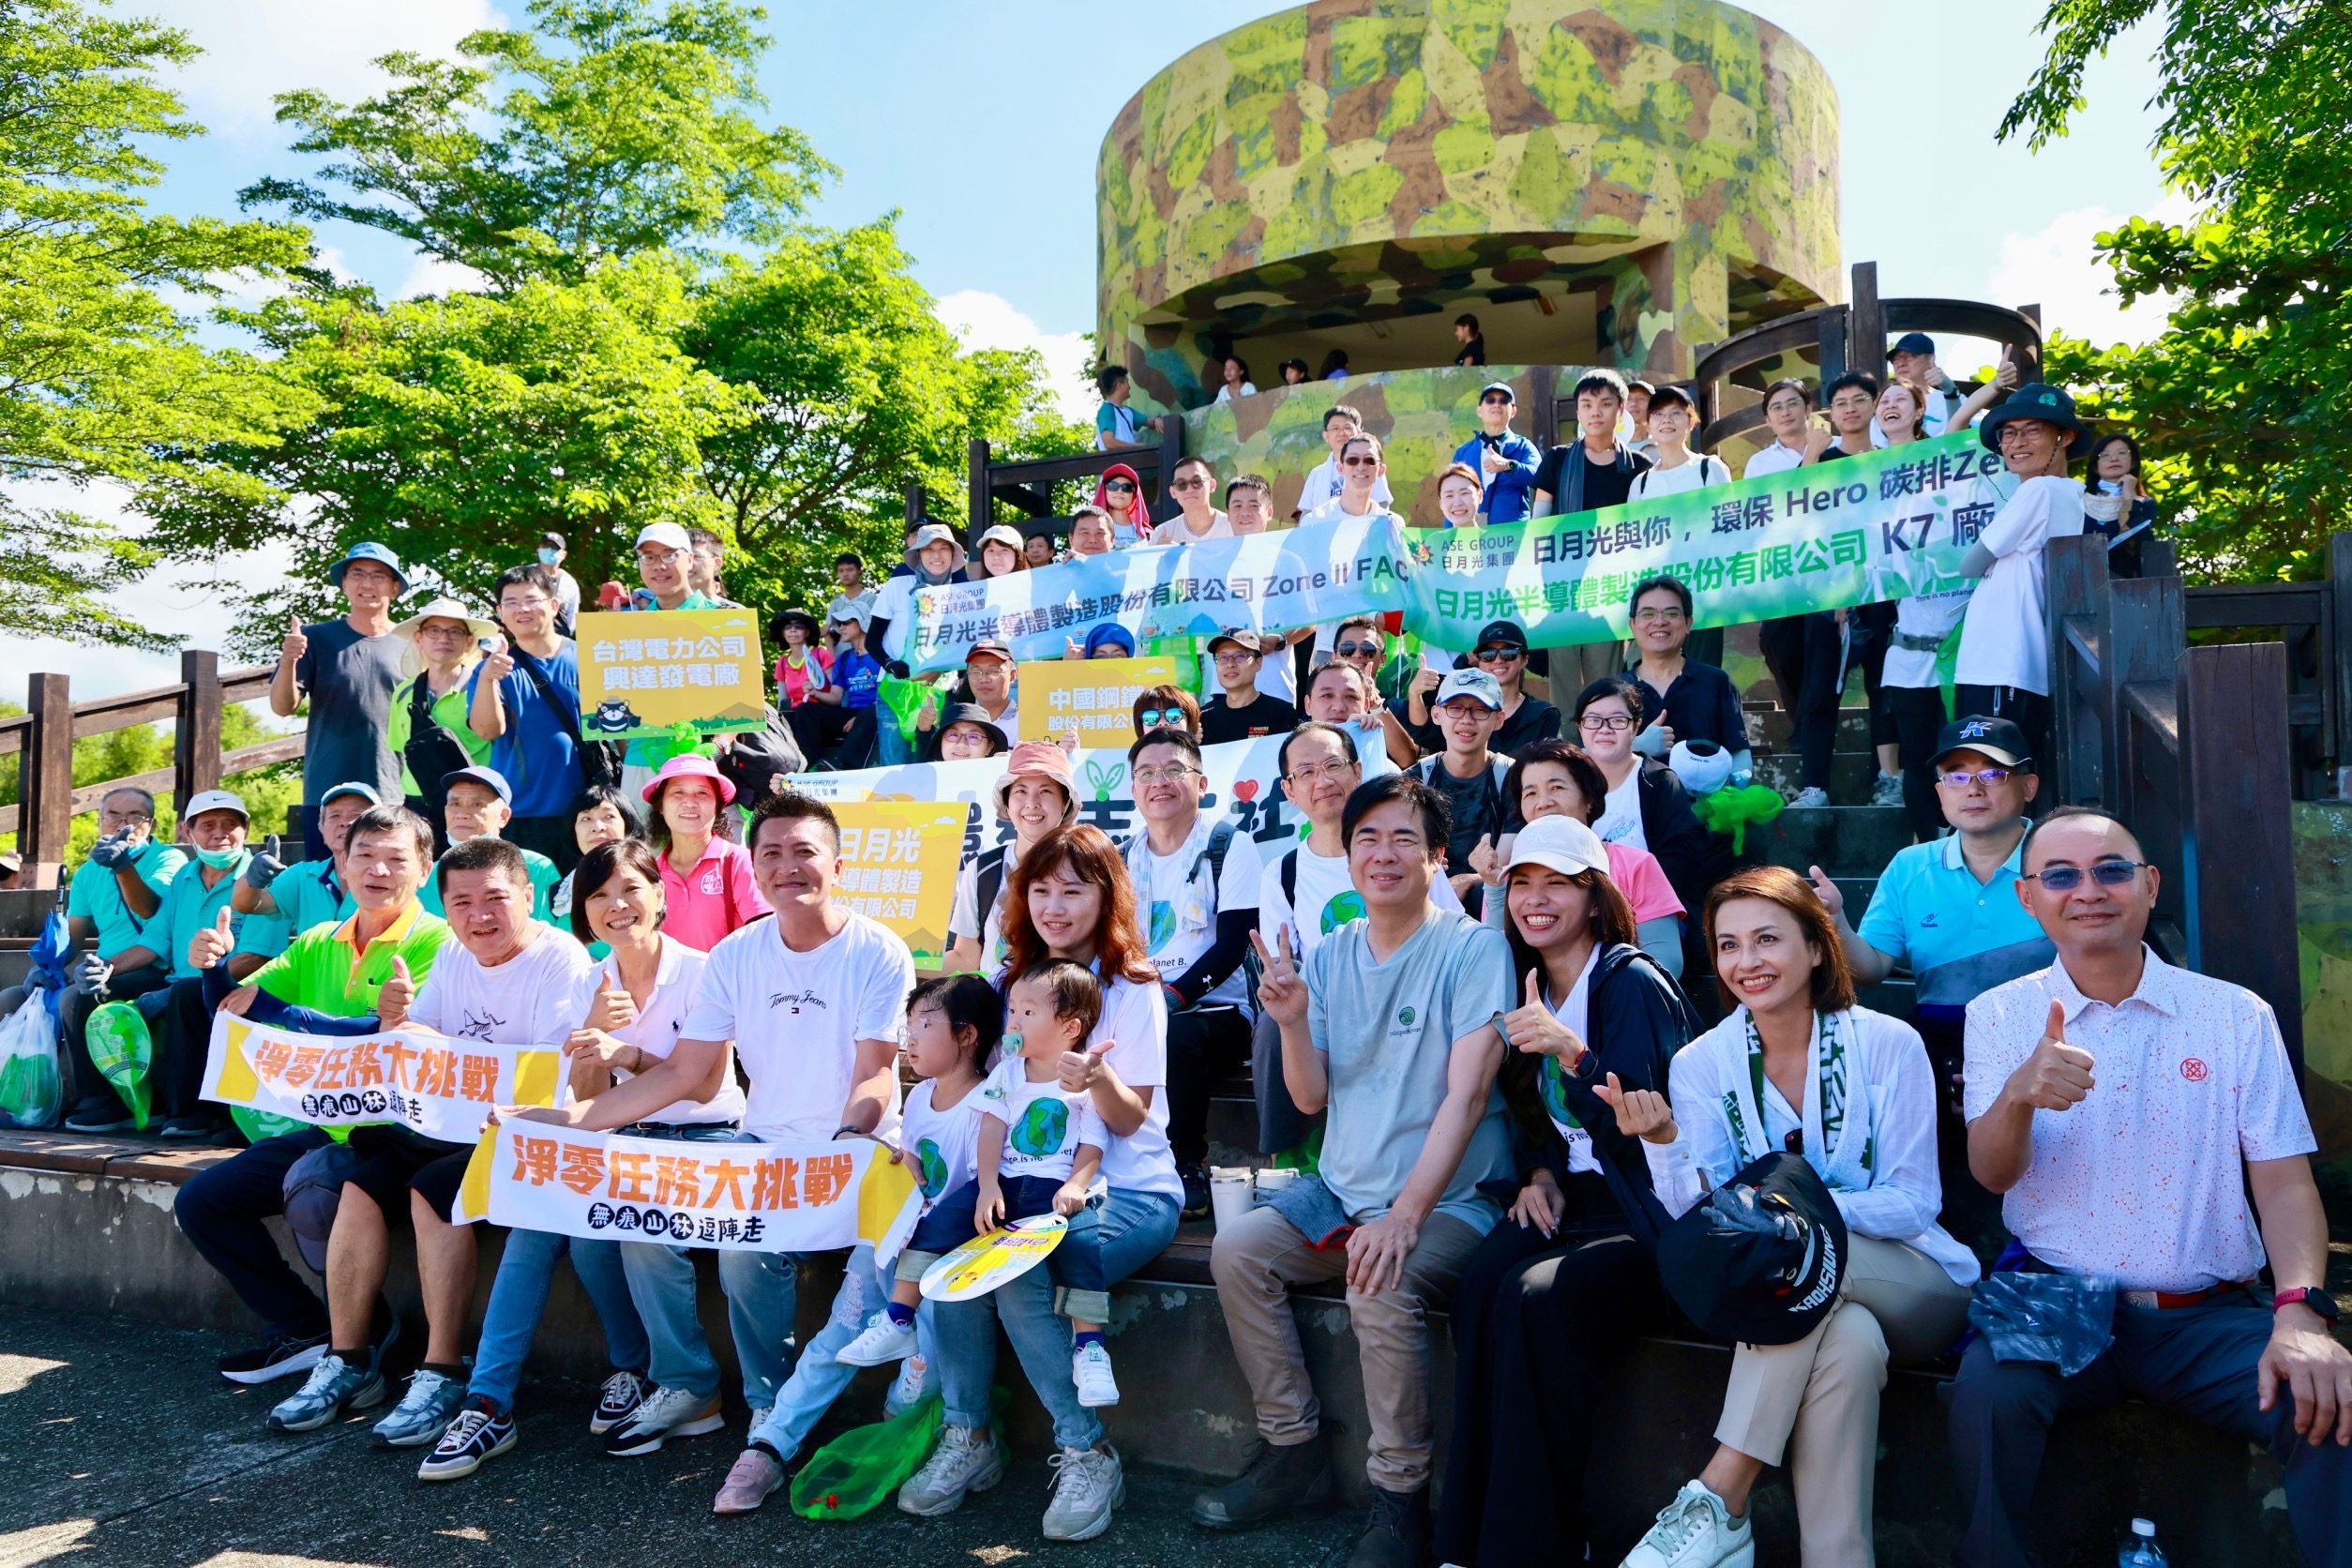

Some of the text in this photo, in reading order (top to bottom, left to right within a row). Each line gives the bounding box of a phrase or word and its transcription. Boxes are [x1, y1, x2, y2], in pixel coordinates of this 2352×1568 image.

[1711, 493, 1774, 535] 環保
[1787, 482, 1868, 518] Hero
[1441, 535, 1515, 551] ASE GROUP
[1882, 513, 1935, 555] K7
[1441, 551, 1515, 570] 日月光集團
[941, 598, 985, 614] 日月光集團
[957, 588, 984, 599] GROUP
[912, 578, 1254, 649] 日月光半導體製造股份有限公司
[1262, 572, 1327, 598] Zone
[592, 636, 746, 663] 台灣電力公司
[602, 662, 740, 690] 興達發電廠
[839, 826, 921, 863] 日月光
[834, 867, 922, 895] 導體製造
[1178, 957, 1187, 966] B.
[770, 989, 826, 1009] Tommy Jeans
[254, 1040, 499, 1103] 淨零任務大挑戰
[511, 1134, 852, 1211] 淨零任務大挑戰
[588, 1202, 765, 1244] 無痕山林逗陣走
[1787, 1223, 1836, 1312] KAOHSIUNG
